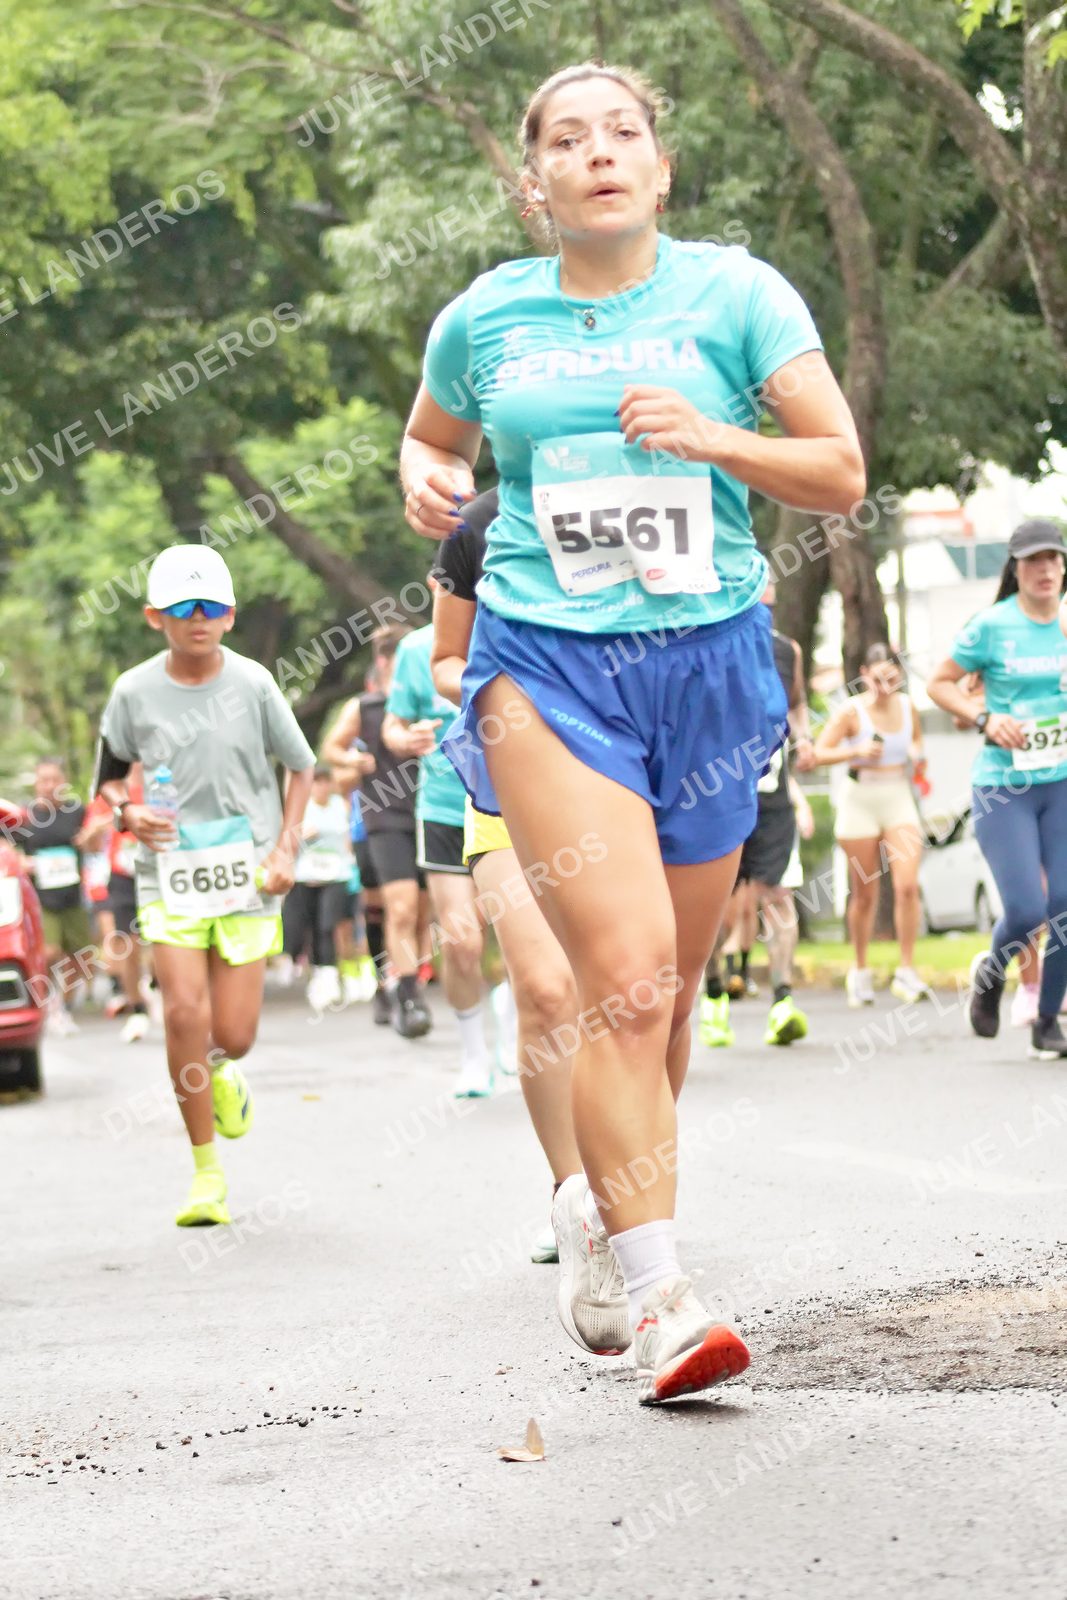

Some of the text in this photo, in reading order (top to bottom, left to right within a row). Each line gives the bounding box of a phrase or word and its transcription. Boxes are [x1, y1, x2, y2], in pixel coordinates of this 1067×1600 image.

[494, 337, 705, 386] PERDURA
[551, 506, 690, 555] 5561
[571, 561, 612, 579] PERDURA
[169, 861, 249, 894] 6685
